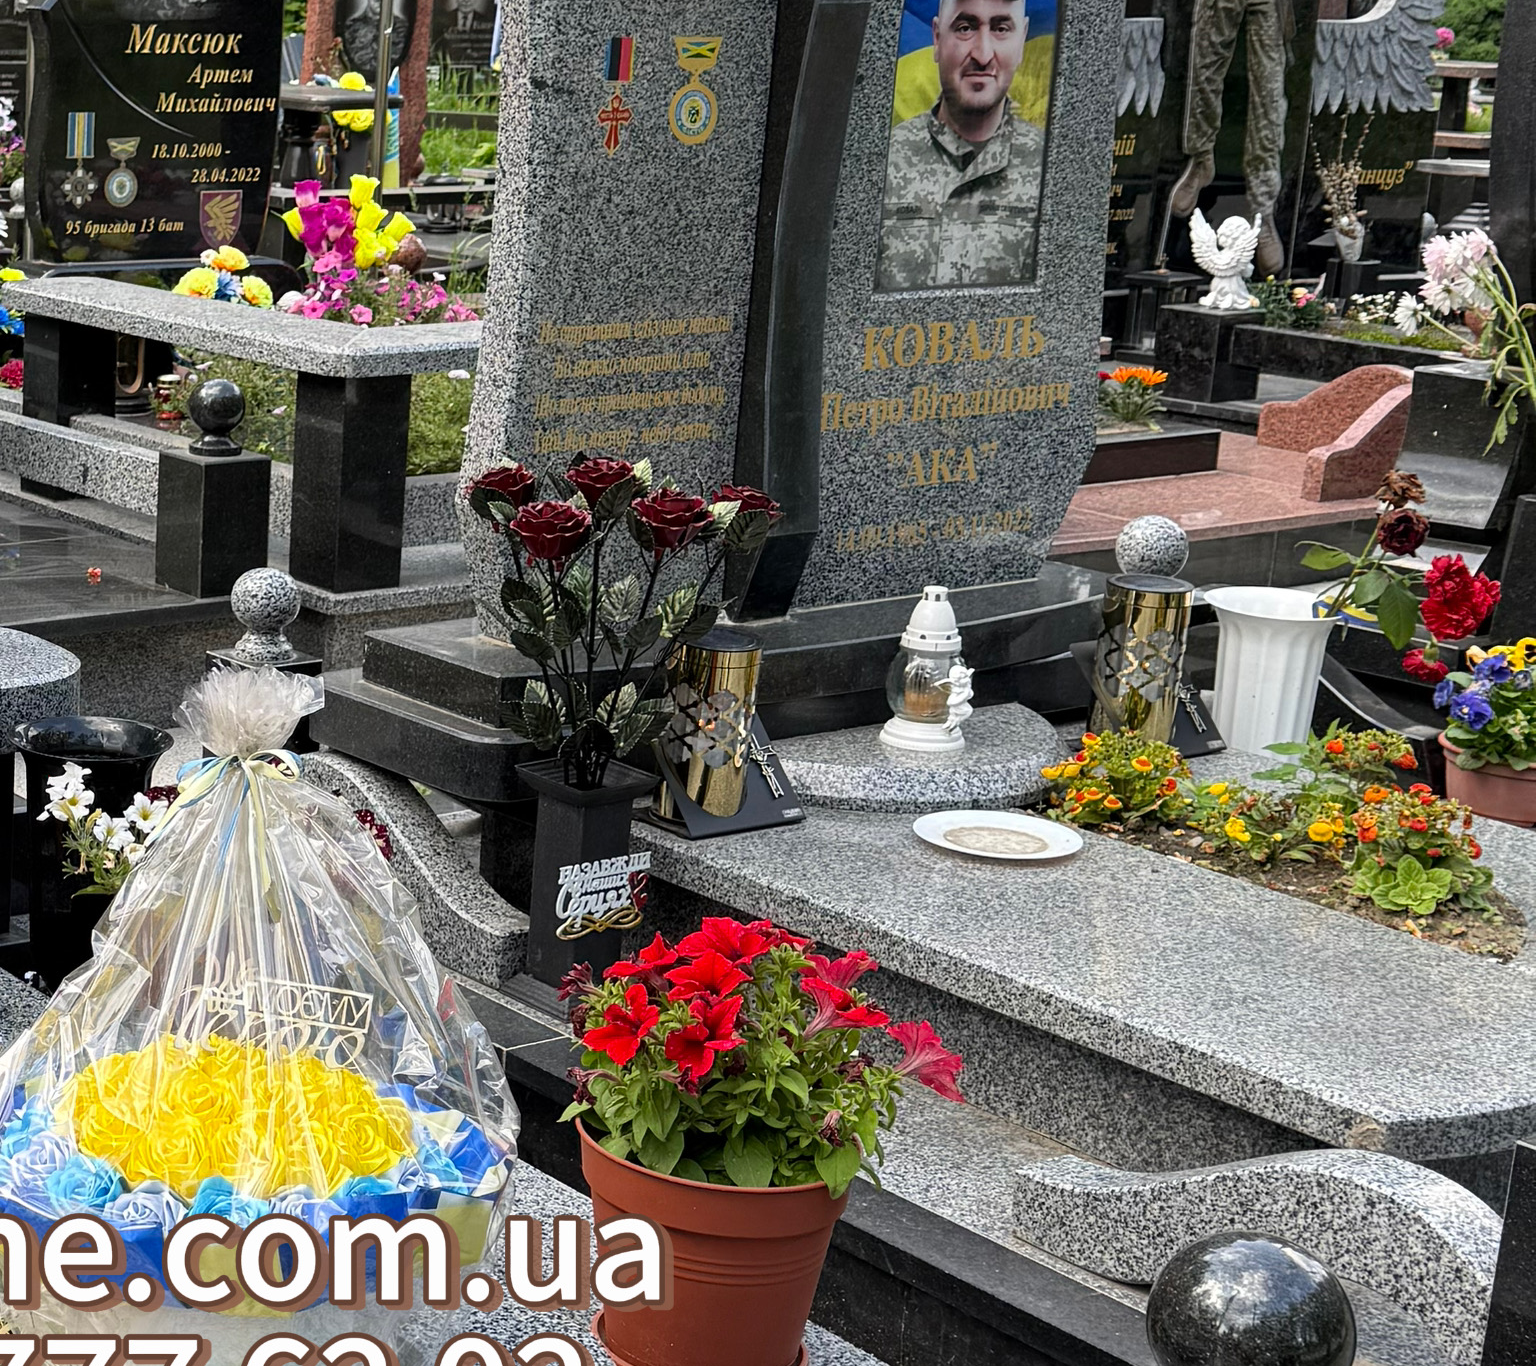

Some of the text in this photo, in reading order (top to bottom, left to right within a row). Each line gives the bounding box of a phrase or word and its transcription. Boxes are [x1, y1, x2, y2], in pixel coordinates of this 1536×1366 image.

[125, 23, 242, 55] Максюк
[187, 63, 253, 89] Артем
[155, 92, 277, 113] Михайлович
[152, 143, 222, 159] 18.10.2000
[191, 168, 261, 183] 28.04.2022
[65, 217, 184, 237] 95 бригада 13 бат
[860, 315, 1046, 371] КОВАЛЬ
[820, 378, 1071, 435] Петро Віталійович
[558, 851, 652, 884] НАЗАВЖДИ
